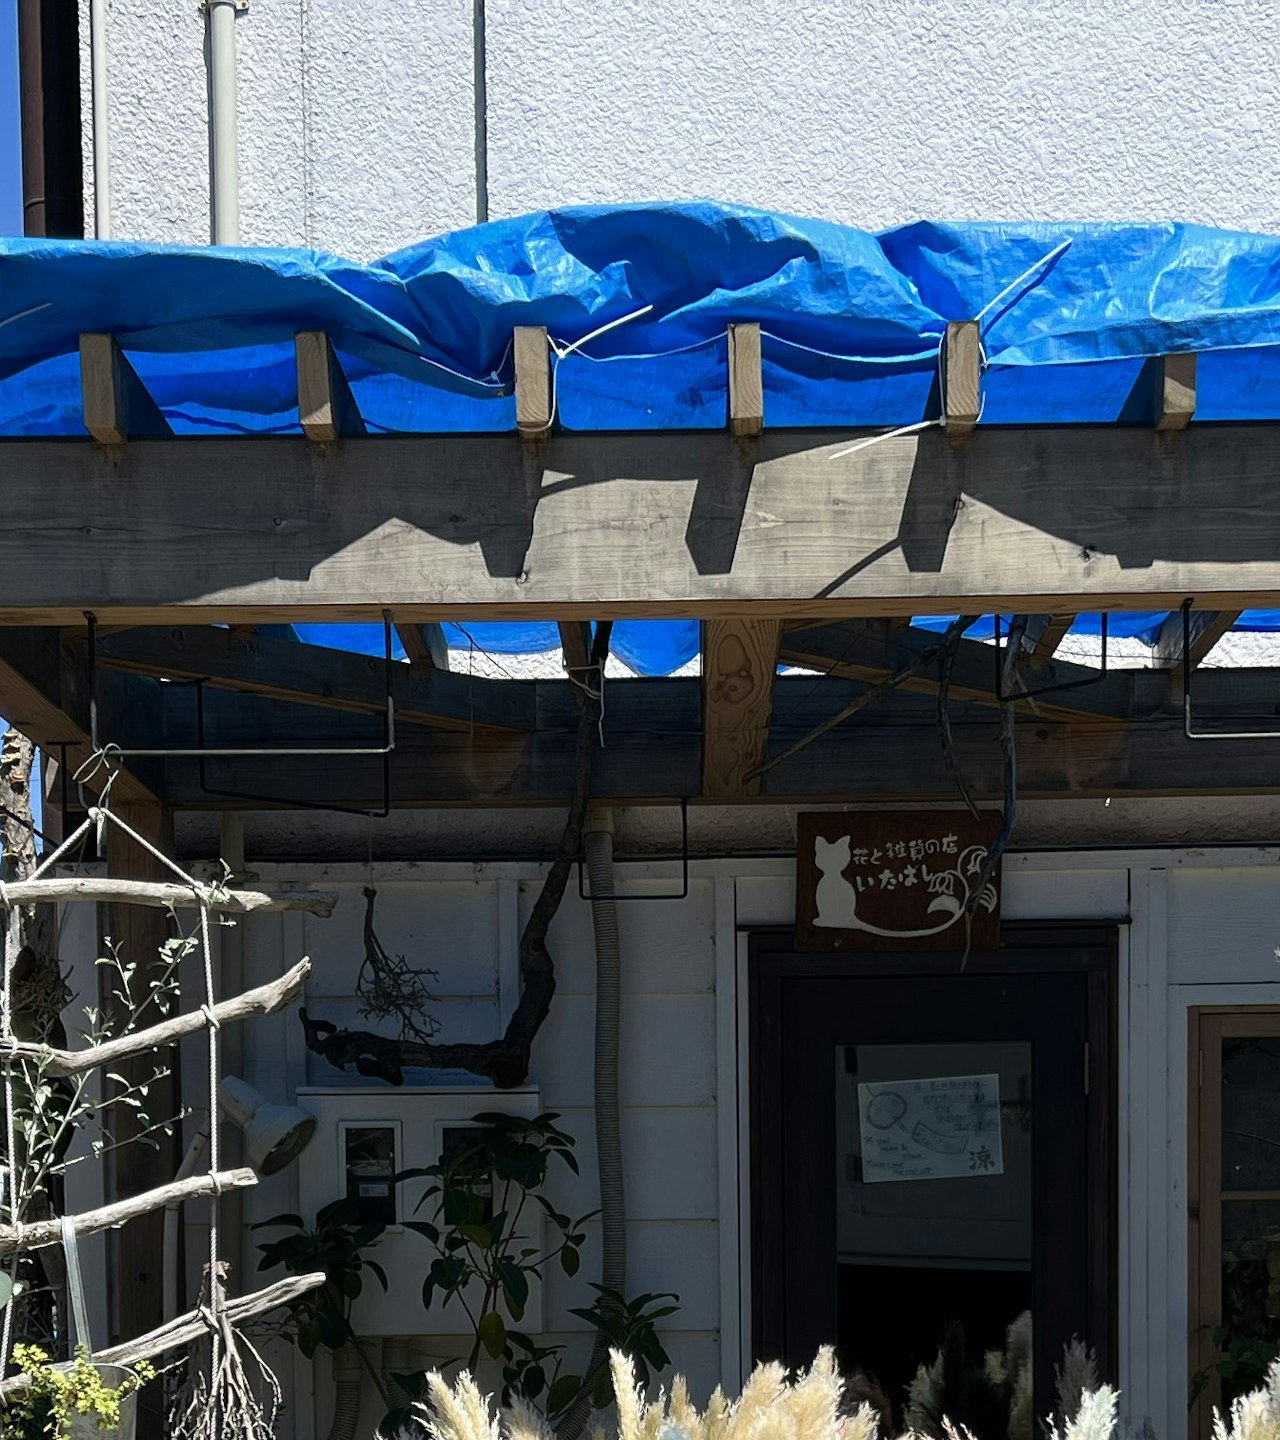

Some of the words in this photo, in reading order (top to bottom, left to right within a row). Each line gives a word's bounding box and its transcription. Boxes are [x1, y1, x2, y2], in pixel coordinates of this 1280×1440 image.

[852, 833, 959, 866] 花と雑貨の店
[855, 864, 934, 893] いたばし
[968, 1144, 996, 1172] 涼
